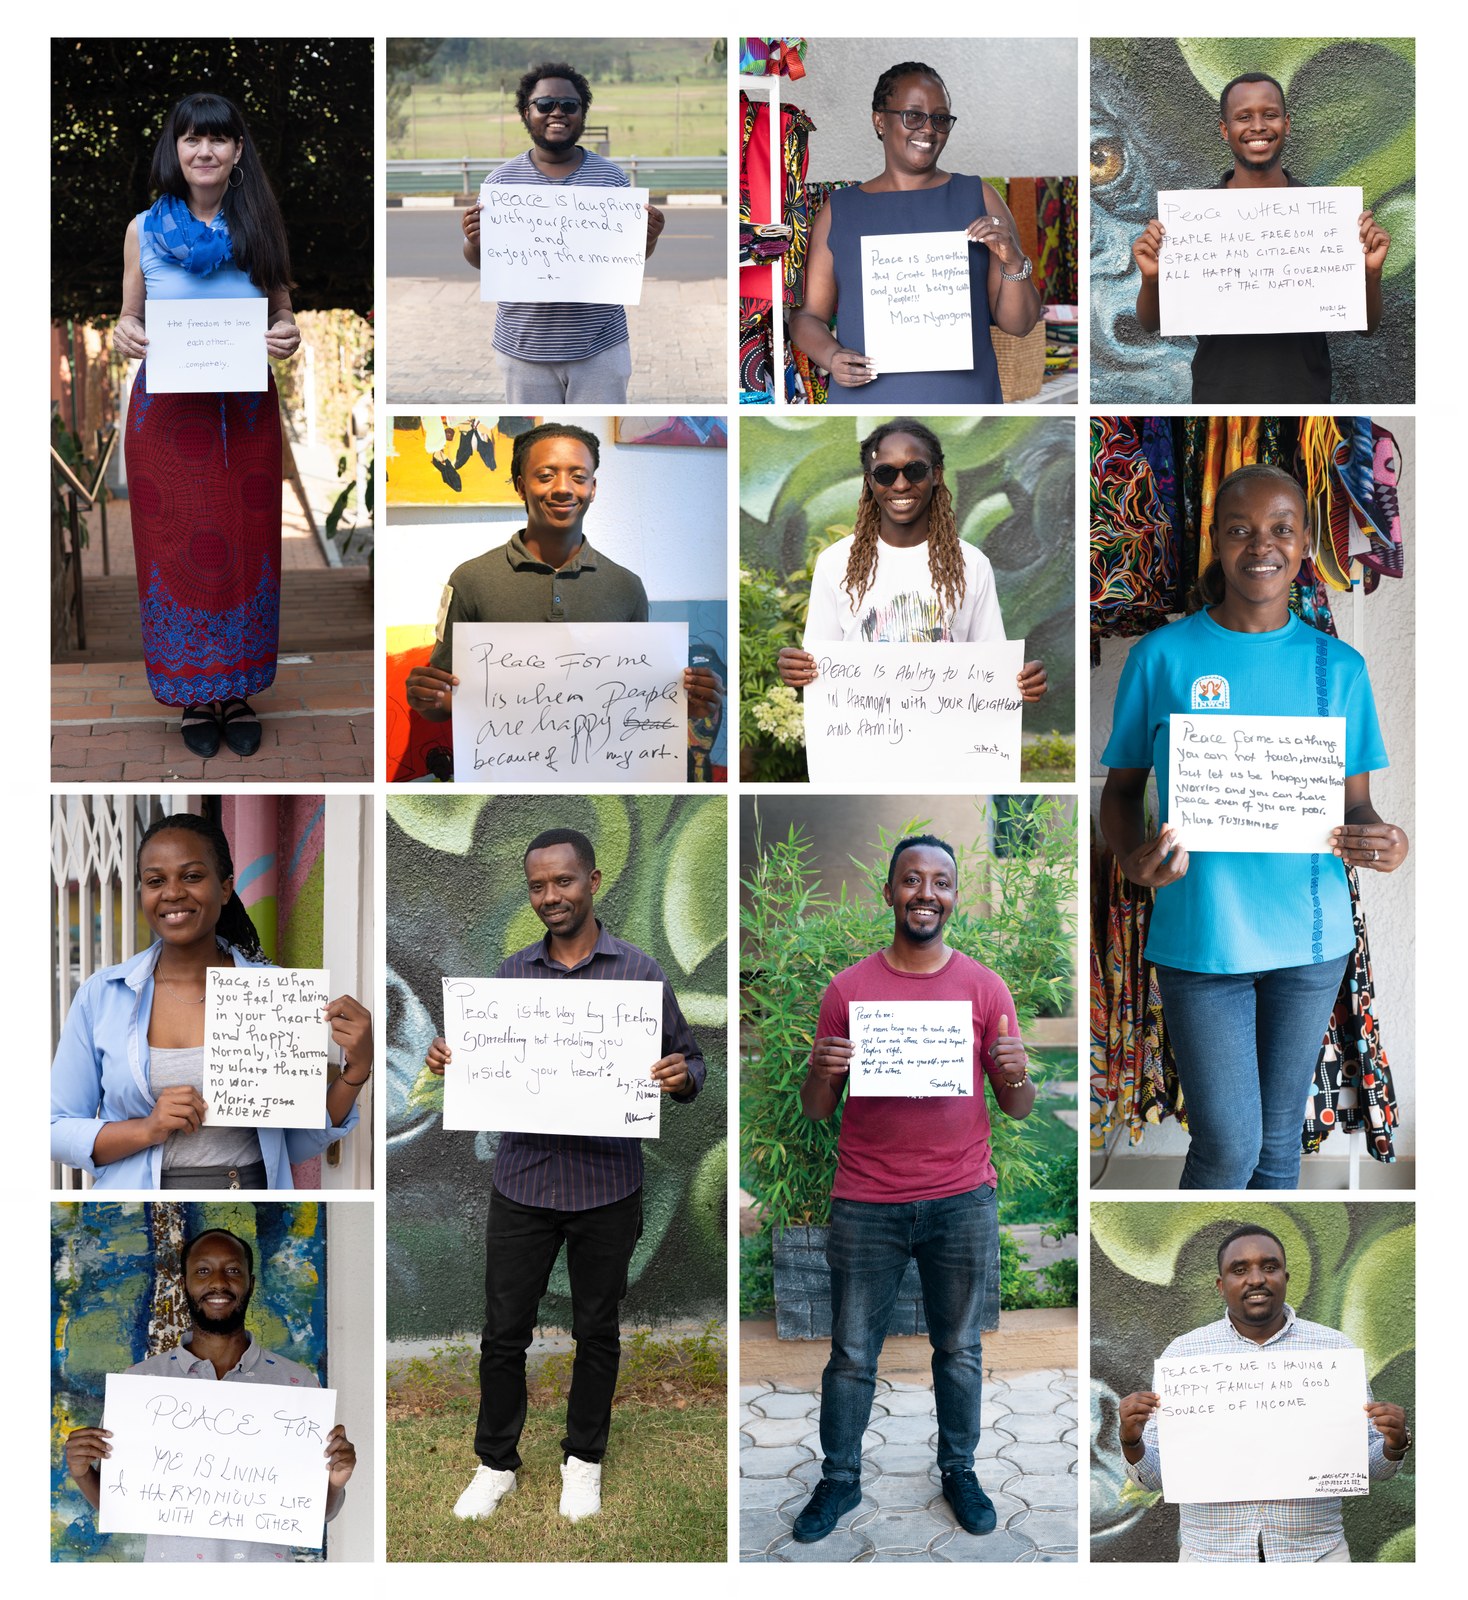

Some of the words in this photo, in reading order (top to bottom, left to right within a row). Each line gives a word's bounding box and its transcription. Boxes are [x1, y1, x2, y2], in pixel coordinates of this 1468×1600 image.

[555, 194, 567, 206] is
[573, 193, 641, 219] laughing
[1238, 203, 1299, 220] WHEN
[1307, 201, 1337, 215] THE
[491, 209, 523, 224] with
[561, 216, 623, 233] friends
[535, 231, 569, 248] and
[1221, 232, 1255, 242] HAVE
[1261, 230, 1314, 239] FREEDOM
[488, 244, 550, 267] enjoying
[555, 248, 584, 263] the
[589, 253, 643, 265] moment
[872, 250, 903, 266] Peace
[1165, 253, 1217, 264] SPEACH
[1226, 250, 1248, 258] AND
[1320, 245, 1344, 253] ARE
[872, 272, 889, 280] that
[1166, 270, 1190, 281] ALL
[1249, 268, 1274, 277] WITH
[1283, 264, 1356, 275] GOVERNMENT
[871, 286, 887, 295] and
[926, 284, 953, 295] being
[1218, 283, 1232, 292] OF
[1238, 281, 1259, 290] THE
[1269, 279, 1315, 289] NATION.
[187, 319, 219, 328] freedom
[890, 311, 920, 324] Mary
[470, 642, 545, 707] Peace
[617, 654, 652, 667] me
[818, 657, 861, 678] PEACE
[874, 664, 885, 678] IS
[943, 667, 958, 682] to
[492, 692, 506, 707] is
[517, 683, 584, 705] when
[827, 689, 838, 707] IN
[901, 696, 926, 709] with
[476, 720, 523, 745] are
[531, 705, 611, 765] happy
[827, 723, 851, 736] AND
[1183, 721, 1227, 743] Peace
[1256, 735, 1273, 743] me
[1305, 735, 1337, 753] thing
[474, 749, 540, 769] because
[606, 750, 633, 768] my
[639, 744, 678, 760] art.
[1235, 751, 1255, 761] not
[1179, 764, 1202, 778] but
[1209, 769, 1223, 778] let
[1248, 771, 1262, 779] be
[1271, 770, 1307, 788] happy
[1296, 791, 1326, 801] have
[1258, 802, 1274, 811] you
[1302, 807, 1326, 816] poor.
[210, 970, 250, 988] Peace
[258, 976, 270, 987] is
[216, 993, 237, 1005] you
[243, 990, 273, 1006] feel
[216, 1008, 227, 1020] in
[235, 1011, 266, 1026] your
[272, 1004, 322, 1024] heart
[517, 1003, 531, 1018] is
[534, 997, 551, 1018] the
[584, 1001, 604, 1033] by
[612, 1003, 657, 1036] feeling
[875, 1010, 882, 1018] to
[212, 1028, 239, 1041] and
[246, 1025, 300, 1050] happy.
[211, 1044, 269, 1061] Normaly,
[274, 1049, 287, 1058] is
[535, 1035, 549, 1045] not
[598, 1038, 624, 1060] you
[210, 1063, 223, 1073] ny
[229, 1059, 268, 1074] where
[311, 1065, 322, 1076] is
[210, 1078, 224, 1086] no
[230, 1079, 258, 1087] war.
[526, 1067, 557, 1094] your
[213, 1090, 255, 1105] Marie
[1161, 1364, 1211, 1382] PEACE
[1214, 1363, 1233, 1372] TO
[1240, 1361, 1258, 1371] ME
[1268, 1362, 1276, 1370] IS
[1284, 1360, 1323, 1370] HAVING
[1331, 1361, 1336, 1369] A
[1164, 1384, 1208, 1396] HAPPY
[1271, 1380, 1293, 1389] AND
[1302, 1378, 1330, 1387] GOOD
[1163, 1405, 1215, 1417] SOURCE
[1229, 1401, 1247, 1410] OF
[1256, 1398, 1306, 1409] INCOME
[146, 1394, 261, 1435] PEACE
[274, 1410, 323, 1444] FOR
[153, 1446, 183, 1474] ME
[194, 1454, 214, 1478] IS
[221, 1457, 278, 1484] LIVING
[109, 1469, 127, 1496] A
[140, 1484, 266, 1506] HARMONIOUS
[280, 1496, 312, 1509] LIFE
[159, 1507, 193, 1524] WITH
[209, 1511, 244, 1527] EAH
[256, 1514, 302, 1533] OTHER
